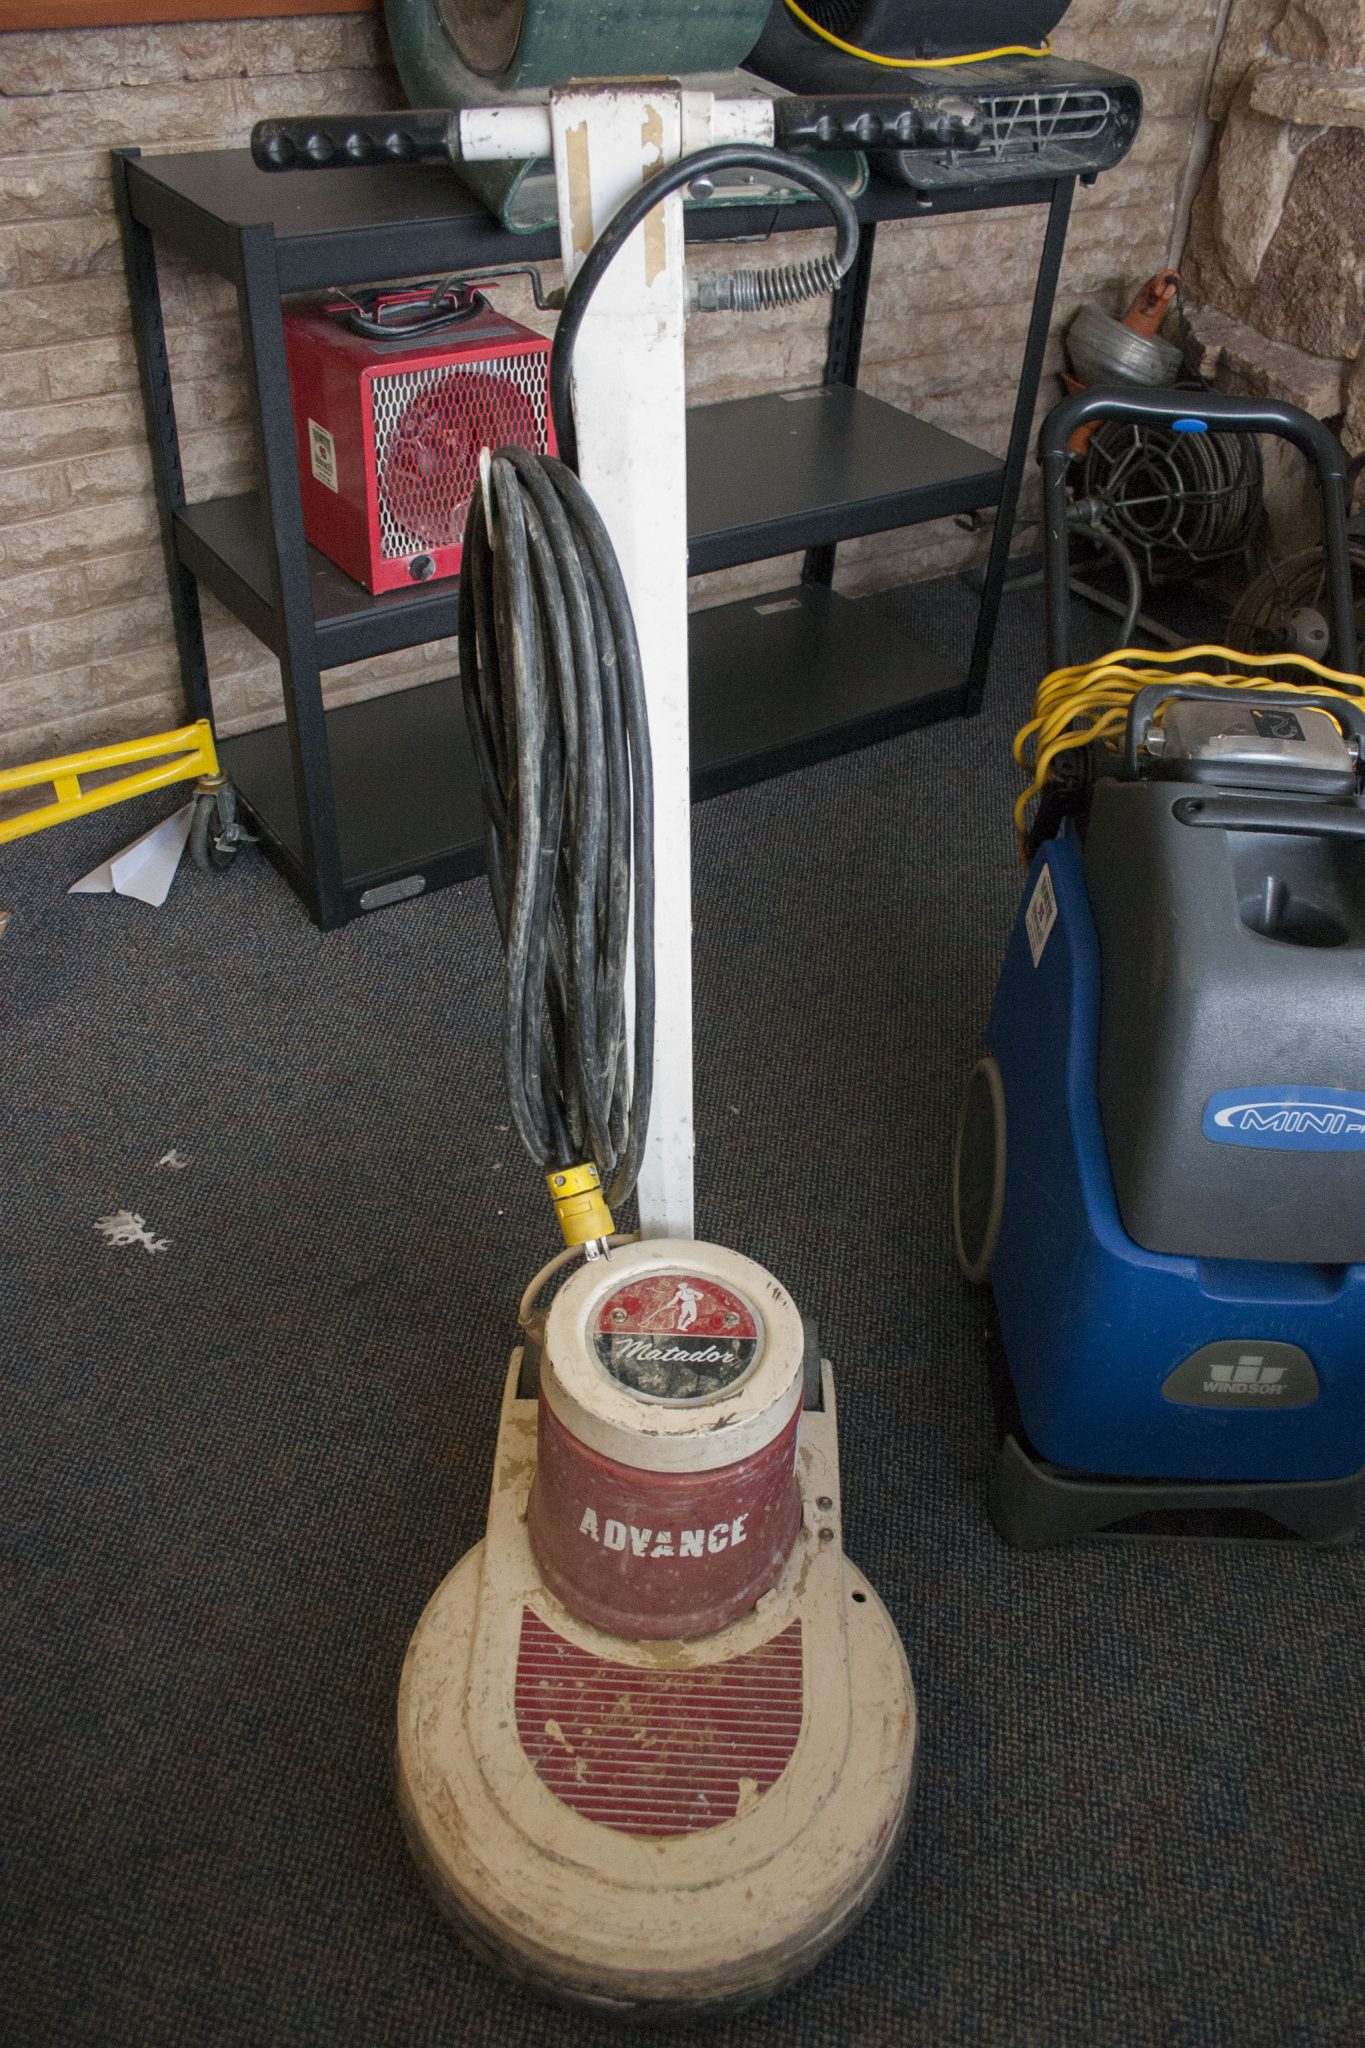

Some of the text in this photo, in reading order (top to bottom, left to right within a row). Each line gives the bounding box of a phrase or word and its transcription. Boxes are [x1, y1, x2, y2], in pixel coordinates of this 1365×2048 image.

[1239, 1109, 1346, 1134] MINI
[616, 1338, 735, 1363] Matador
[1203, 1381, 1283, 1395] WINDSOR
[579, 1507, 749, 1558] ADVANCE
